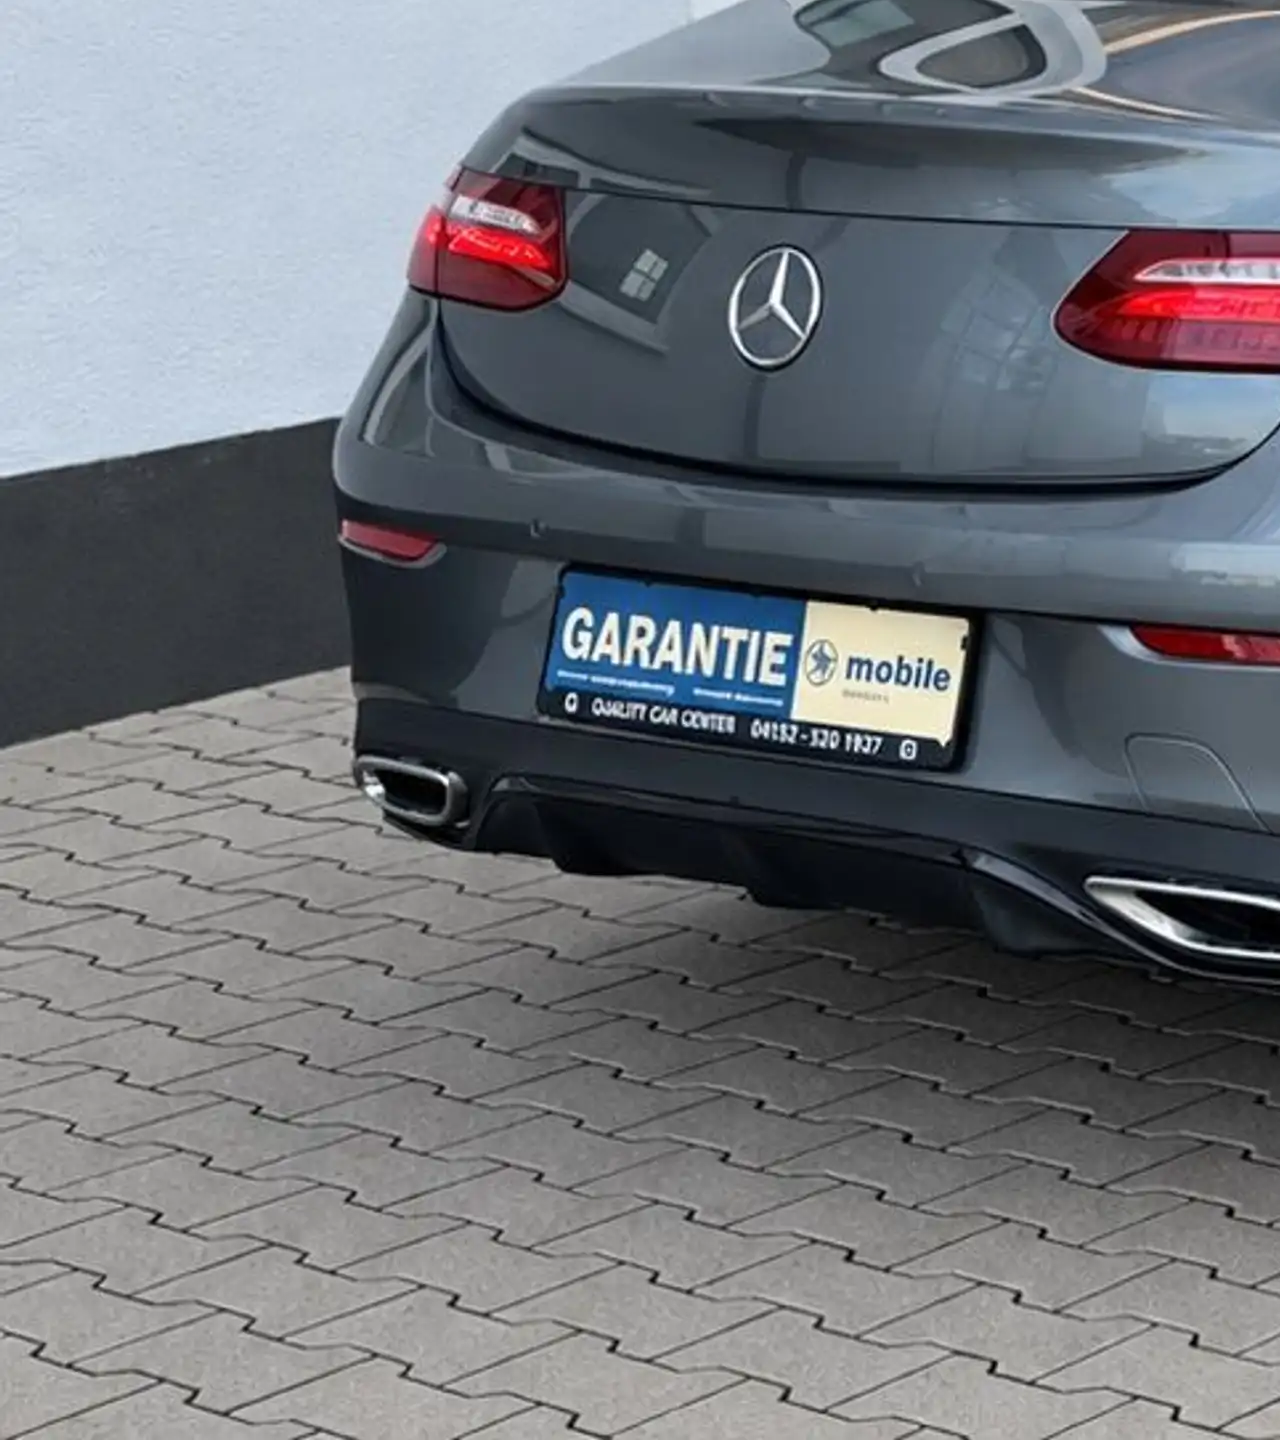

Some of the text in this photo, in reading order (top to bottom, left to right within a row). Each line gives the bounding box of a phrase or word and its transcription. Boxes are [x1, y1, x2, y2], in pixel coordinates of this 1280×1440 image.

[563, 606, 793, 687] GARANTIE
[846, 654, 951, 692] mobile
[591, 696, 648, 722] QUALITY
[649, 705, 678, 726] CAR
[681, 708, 736, 734] CENTER
